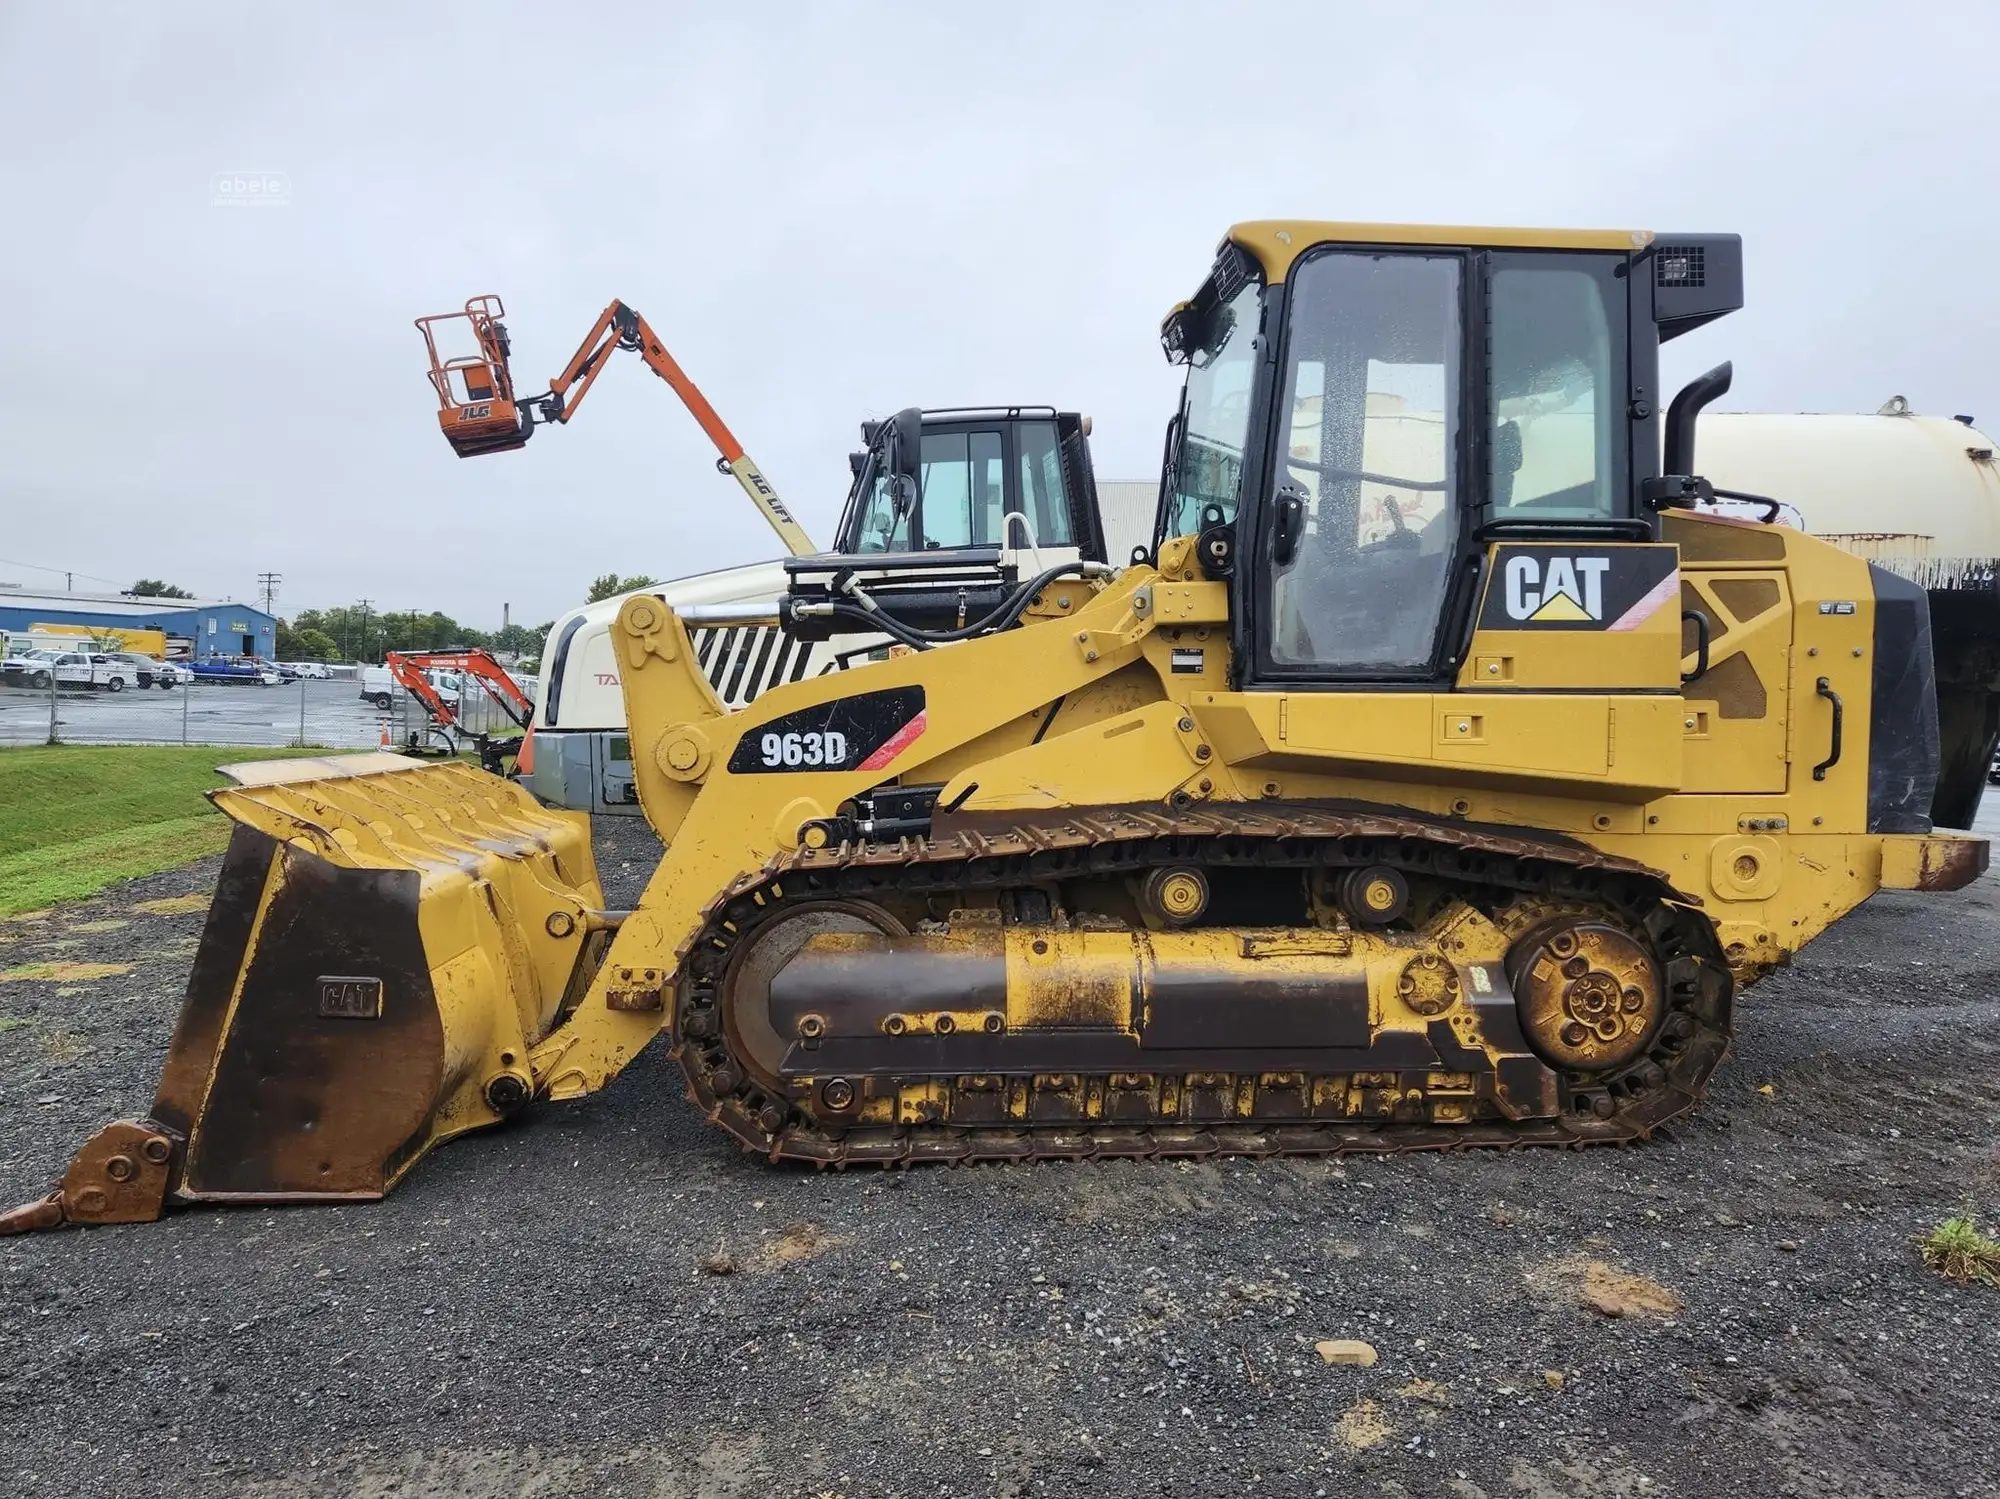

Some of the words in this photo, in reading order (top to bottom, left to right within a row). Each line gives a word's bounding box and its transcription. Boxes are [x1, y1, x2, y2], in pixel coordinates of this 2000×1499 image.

[458, 405, 490, 422] JLG
[747, 473, 771, 494] JLG
[766, 498, 793, 523] LIFT
[1505, 555, 1610, 620] CAT
[761, 732, 846, 767] 963D
